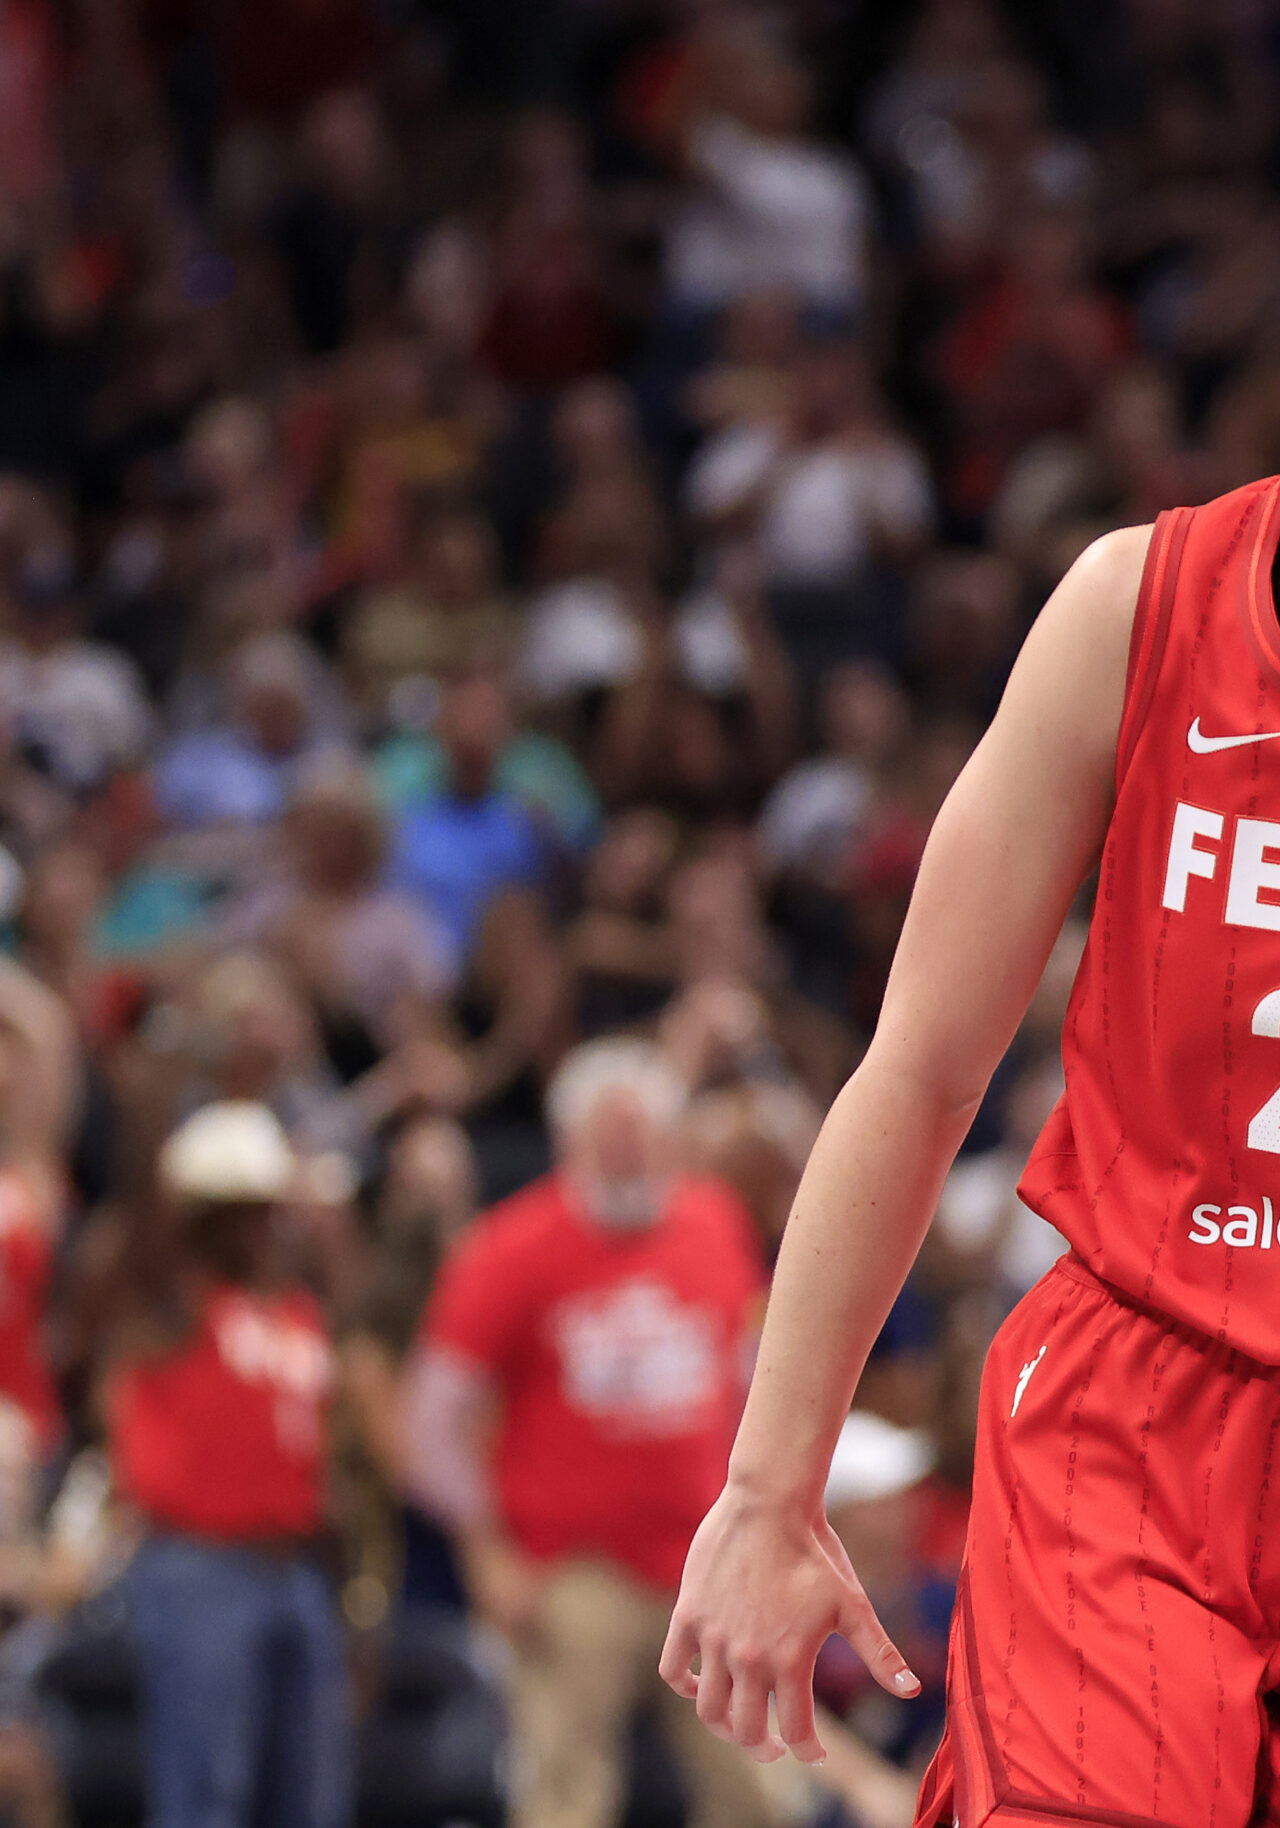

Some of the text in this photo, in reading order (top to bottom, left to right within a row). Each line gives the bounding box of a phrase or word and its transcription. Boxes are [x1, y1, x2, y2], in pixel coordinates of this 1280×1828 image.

[1152, 1363, 1168, 1393] ME
[1211, 1391, 1231, 1452] 2009
[1065, 1435, 1080, 1497] 2009
[1065, 1571, 1077, 1632] 2020
